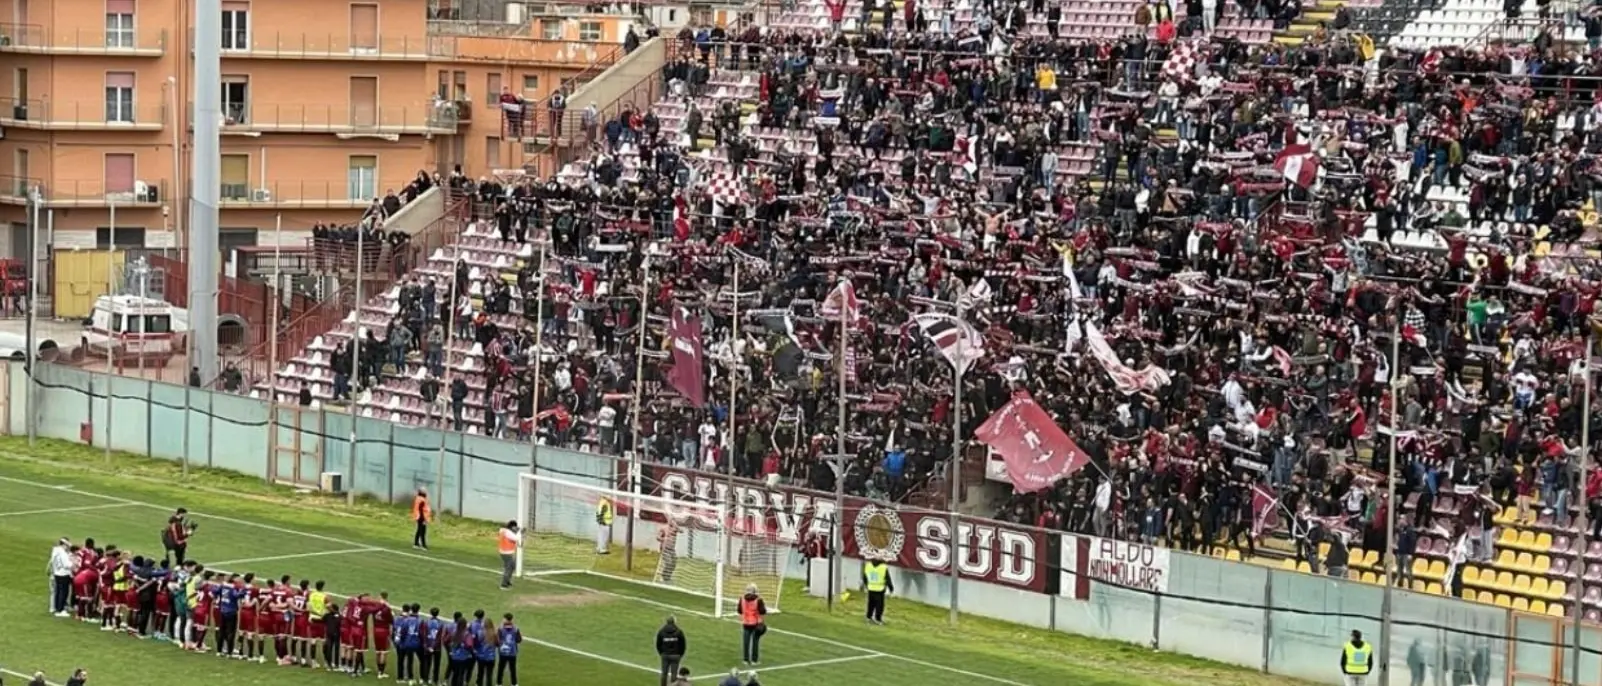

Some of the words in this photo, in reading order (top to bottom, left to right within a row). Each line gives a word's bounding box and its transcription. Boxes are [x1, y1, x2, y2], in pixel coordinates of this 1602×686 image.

[661, 472, 838, 542] CURVA
[916, 516, 1036, 585] SUD
[1101, 539, 1154, 567] ALDO
